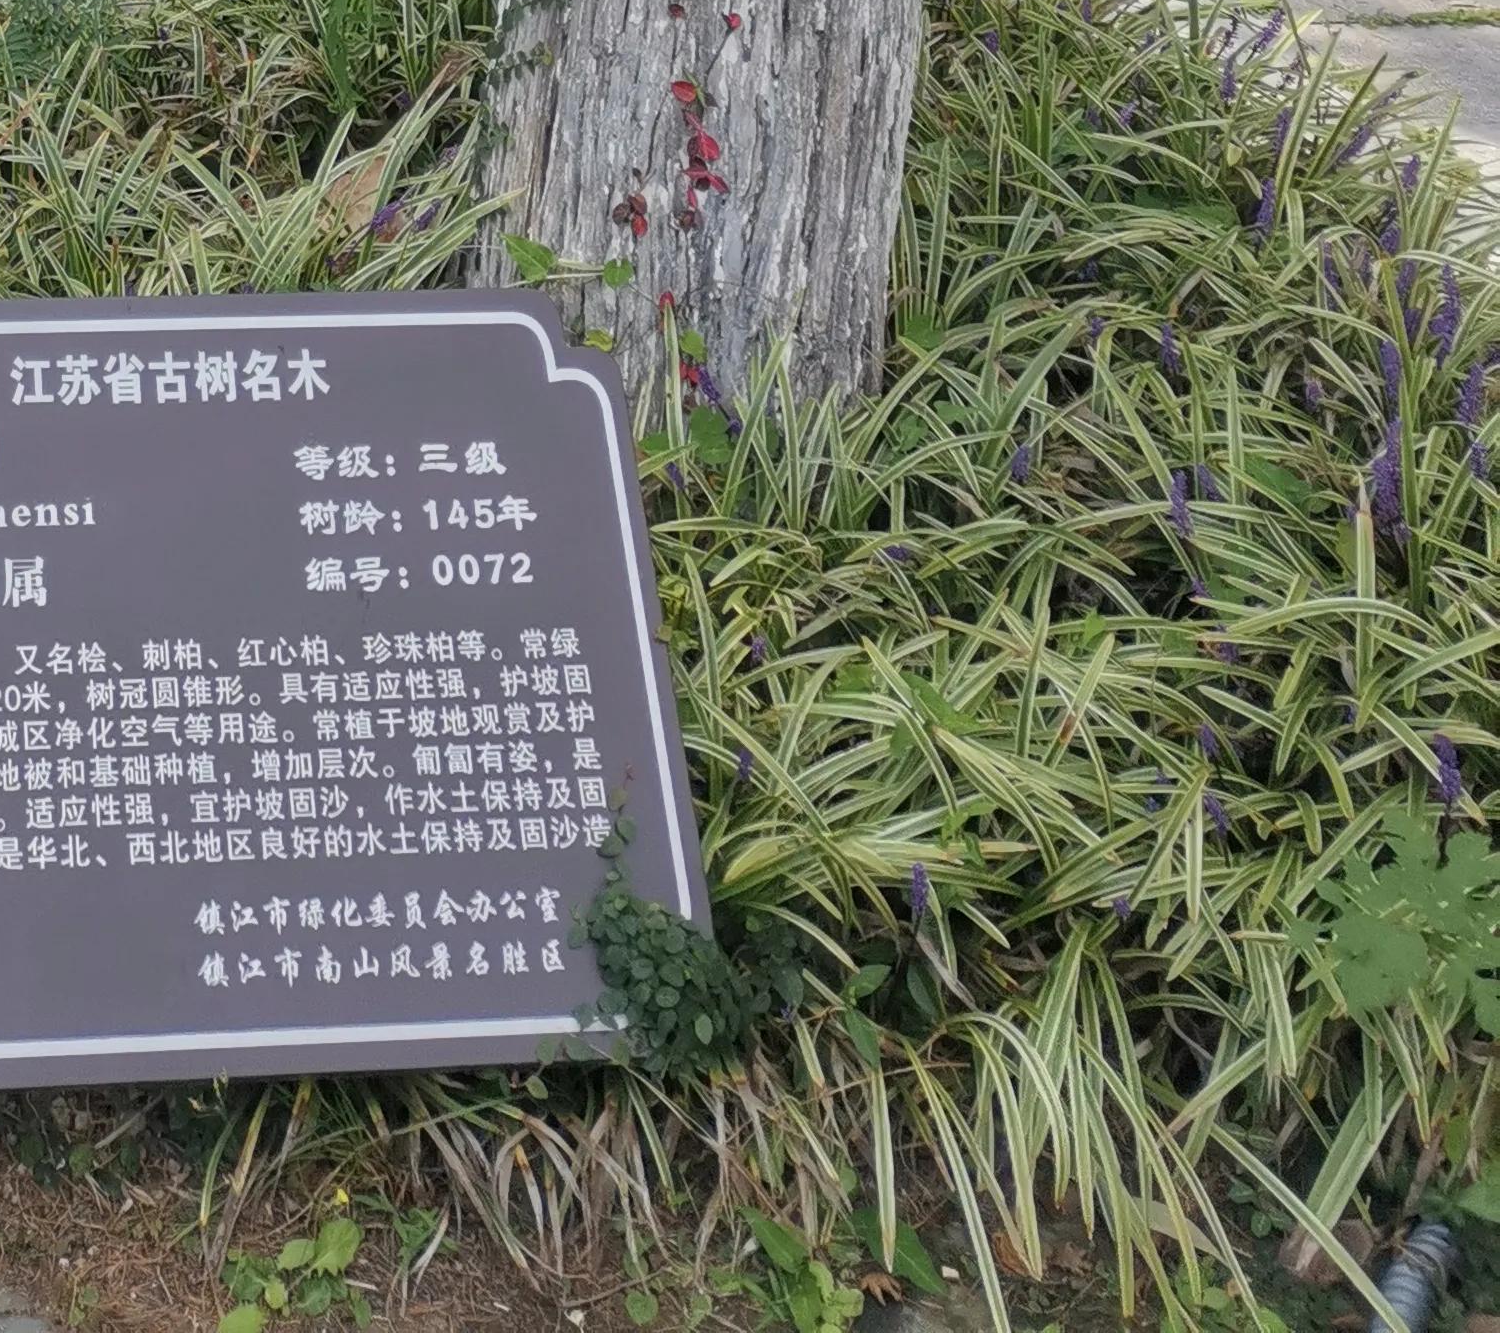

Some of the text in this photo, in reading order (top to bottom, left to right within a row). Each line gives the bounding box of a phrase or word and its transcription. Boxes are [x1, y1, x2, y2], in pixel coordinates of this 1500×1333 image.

[9, 349, 331, 406] 江苏省古树名木
[193, 886, 561, 935] 镇江市绿化委员会办公室
[197, 938, 565, 988] 镇江市南山风景名胜区
